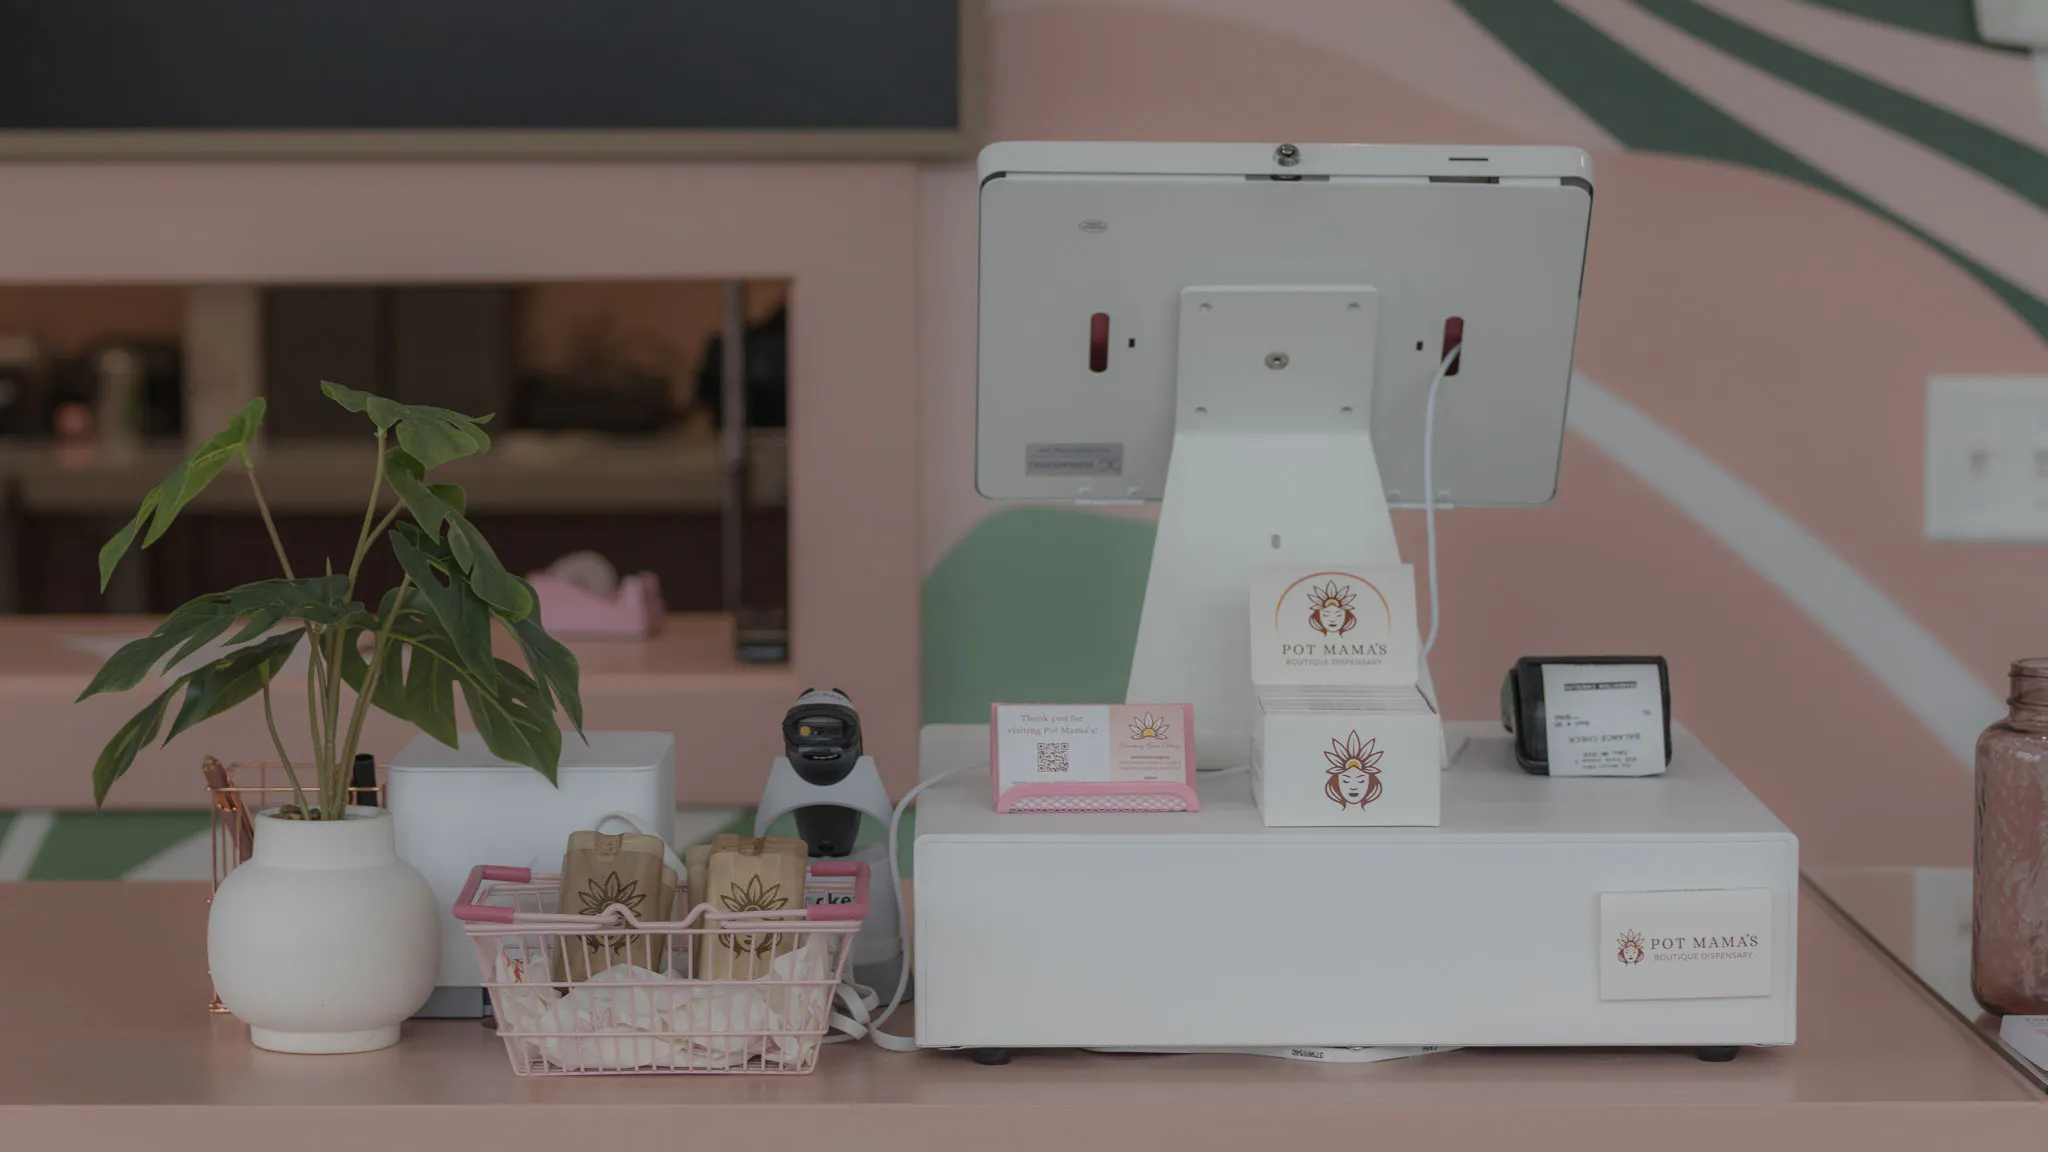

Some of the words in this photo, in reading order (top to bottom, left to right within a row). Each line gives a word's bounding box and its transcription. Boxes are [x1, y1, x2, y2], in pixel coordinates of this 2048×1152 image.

[1281, 643, 1316, 655] POT
[1323, 642, 1388, 655] MAMA'S
[1285, 658, 1329, 667] BOUTIQUE
[1331, 658, 1382, 666] DISPENSARY
[1020, 713, 1049, 723] Thank
[1051, 715, 1069, 724] you
[1071, 714, 1084, 723] for
[1007, 726, 1041, 736] visiting
[1043, 726, 1058, 735] Pot
[1060, 726, 1099, 735] Mama's!
[1568, 735, 1599, 744] CHECK
[1600, 732, 1640, 743] BALANCE
[1650, 937, 1686, 950] POT
[1693, 933, 1759, 950] MAMA'S
[1654, 952, 1699, 962] BOUTIQUE
[1700, 951, 1754, 960] DISPENSARY
